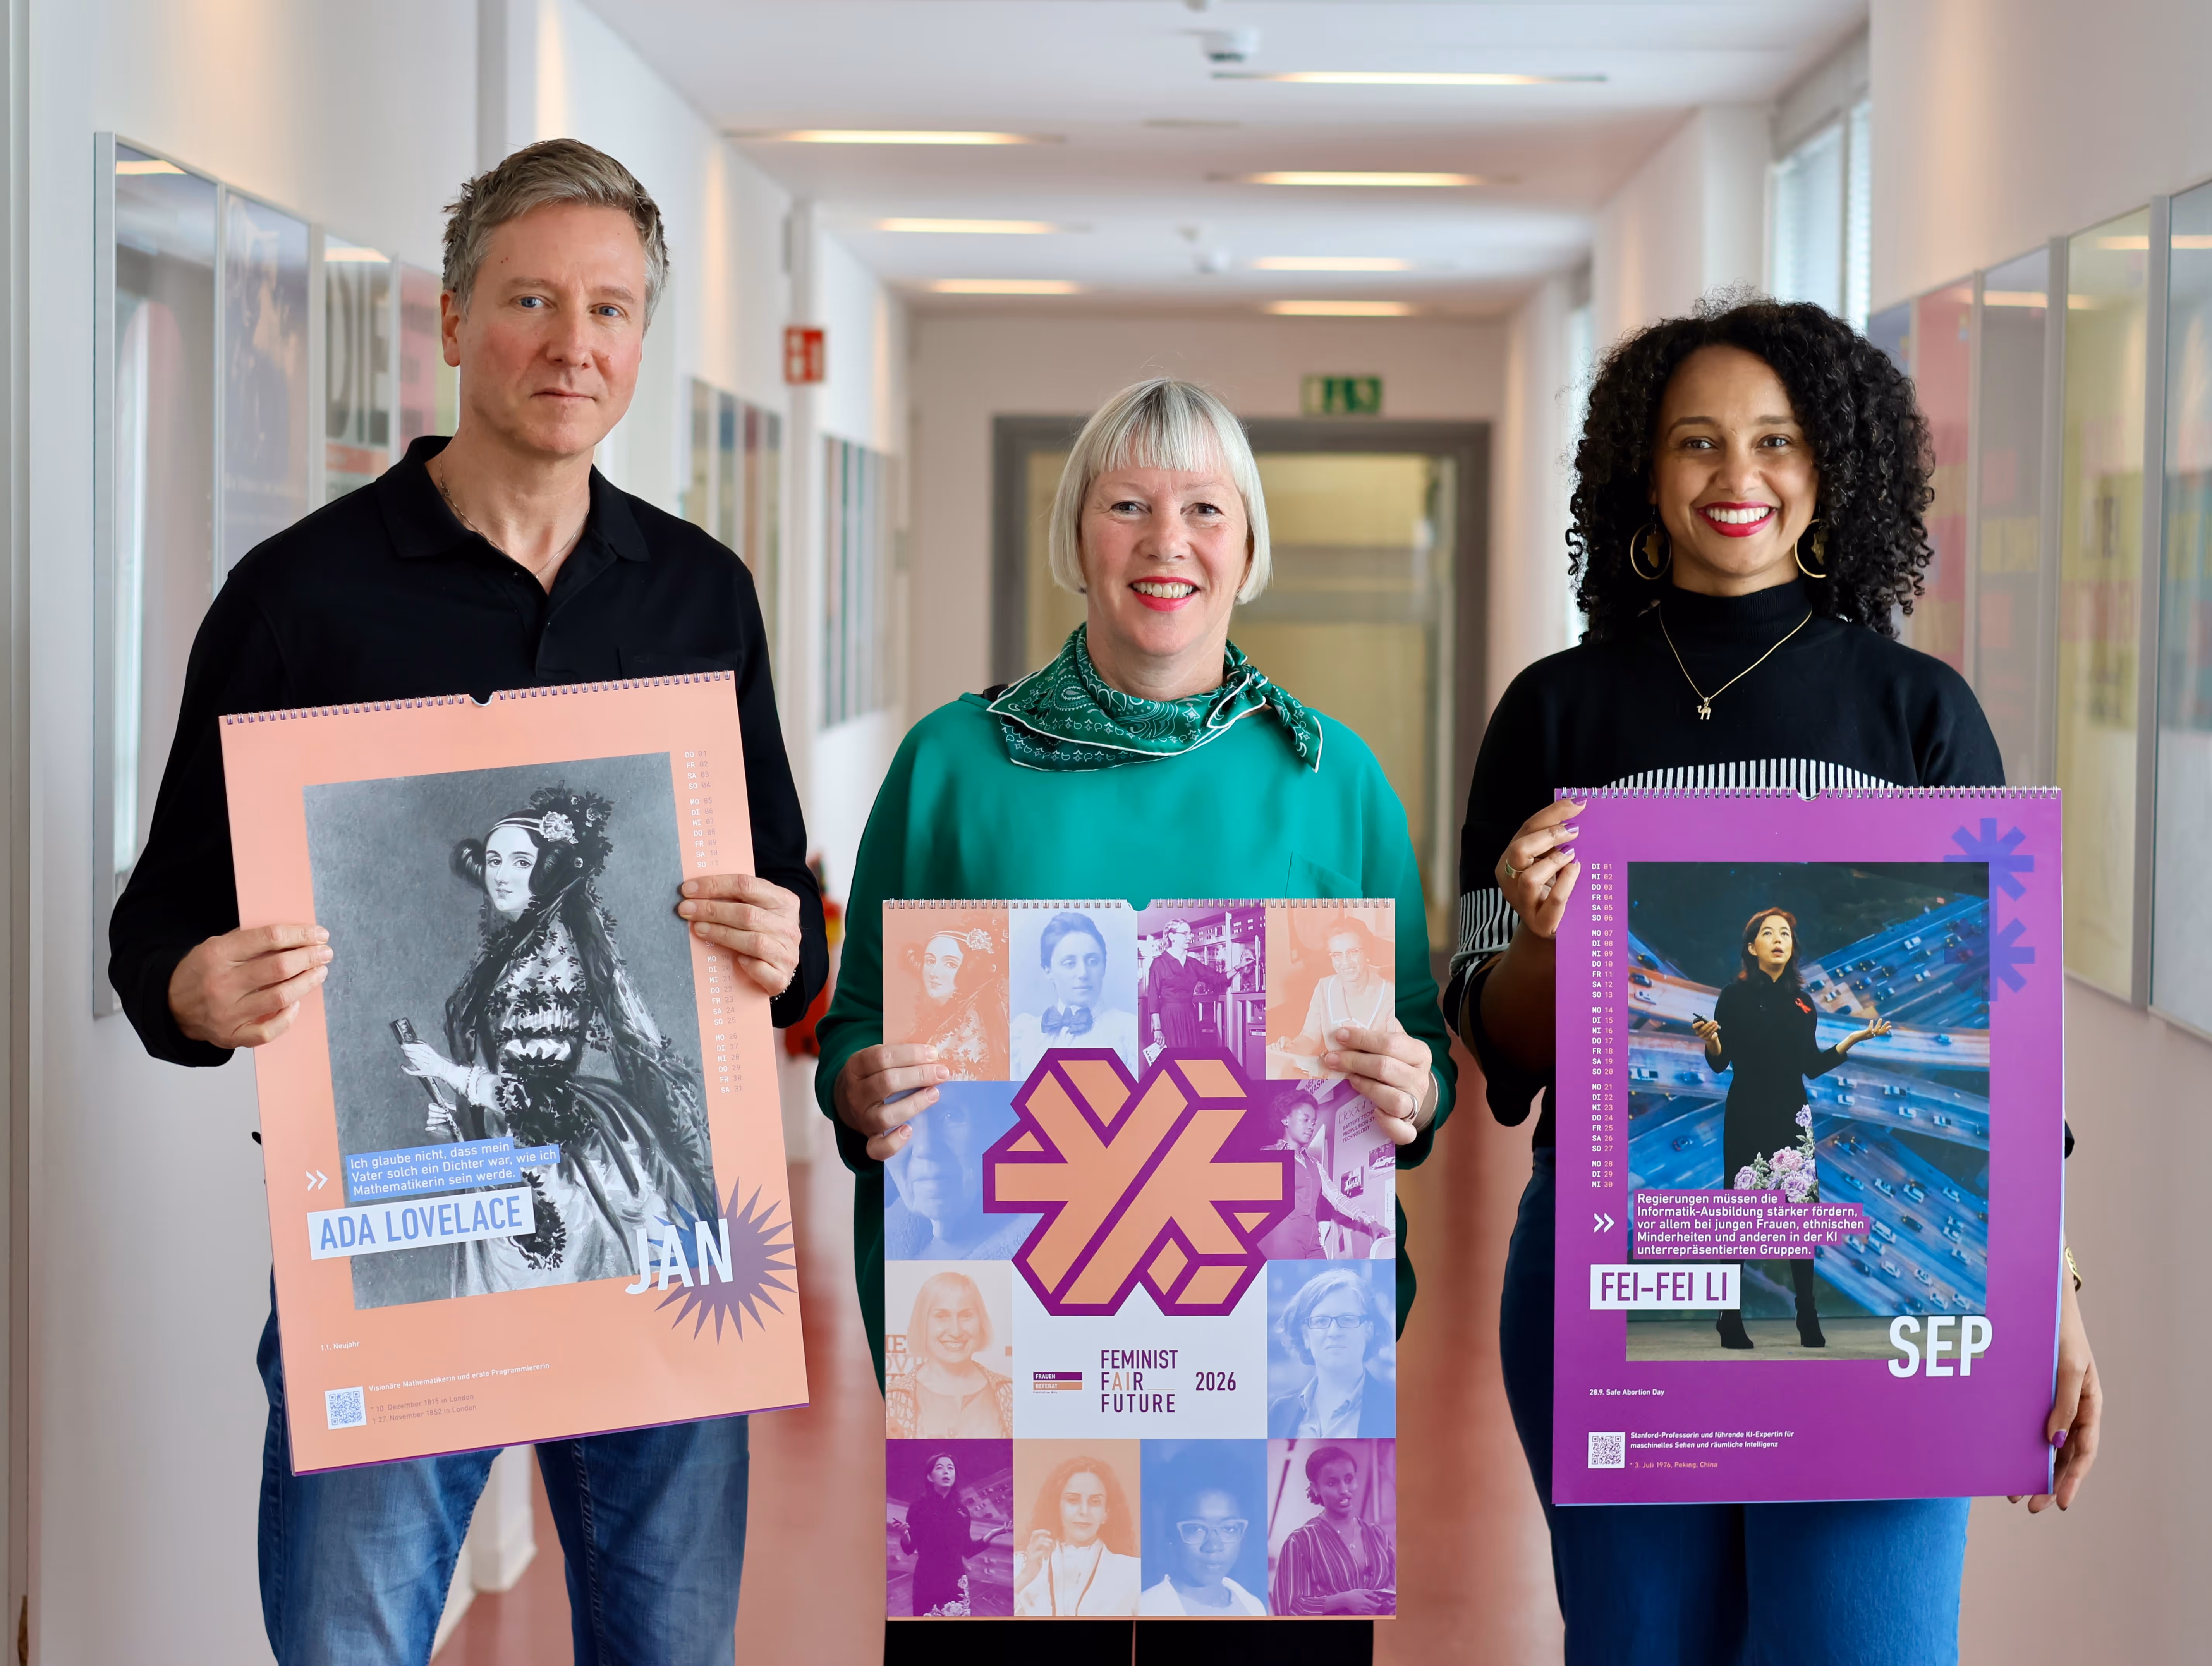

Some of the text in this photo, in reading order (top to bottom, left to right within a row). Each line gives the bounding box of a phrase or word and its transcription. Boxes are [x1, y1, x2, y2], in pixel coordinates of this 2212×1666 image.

[1342, 1120, 1368, 1137] PROPULSION
[1342, 1125, 1370, 1142] TECHNOLOGY
[351, 1144, 509, 1169] Ich glaube nicht, dass mein
[352, 1149, 556, 1182] Vater solch ein Dichter war, wie ich
[354, 1169, 515, 1195] Mathematikerin sein werde.
[1638, 1194, 1778, 1206] Regierungen müssen die
[1638, 1206, 1857, 1218] Informatik-Ausbildung stärker fördern,
[321, 1195, 522, 1250] ADA LOVELACE
[1659, 1219, 1690, 1229] allem
[1695, 1219, 1711, 1229] bei
[1714, 1219, 1752, 1231] jungen
[1757, 1219, 1799, 1230] Frauen,
[1803, 1219, 1863, 1229] ethnischen
[1638, 1231, 1837, 1242] Minderheiten und anderen in der KI
[625, 1218, 733, 1294] JAN
[1638, 1244, 1811, 1256] unterrepräsentierten Gruppen.
[1601, 1272, 1727, 1301] FEI-FEI LI
[1888, 1316, 1992, 1378] SEP
[1101, 1350, 1178, 1369] FEMINIST
[369, 1383, 400, 1391] Visionäre
[403, 1376, 455, 1387] Mathematikerin
[491, 1363, 549, 1376] Programmiererin
[1101, 1372, 1143, 1391] FAIR
[1195, 1372, 1236, 1391] 2026
[388, 1402, 421, 1410] Dezember
[1101, 1394, 1175, 1412] FUTURE
[390, 1412, 424, 1421] November
